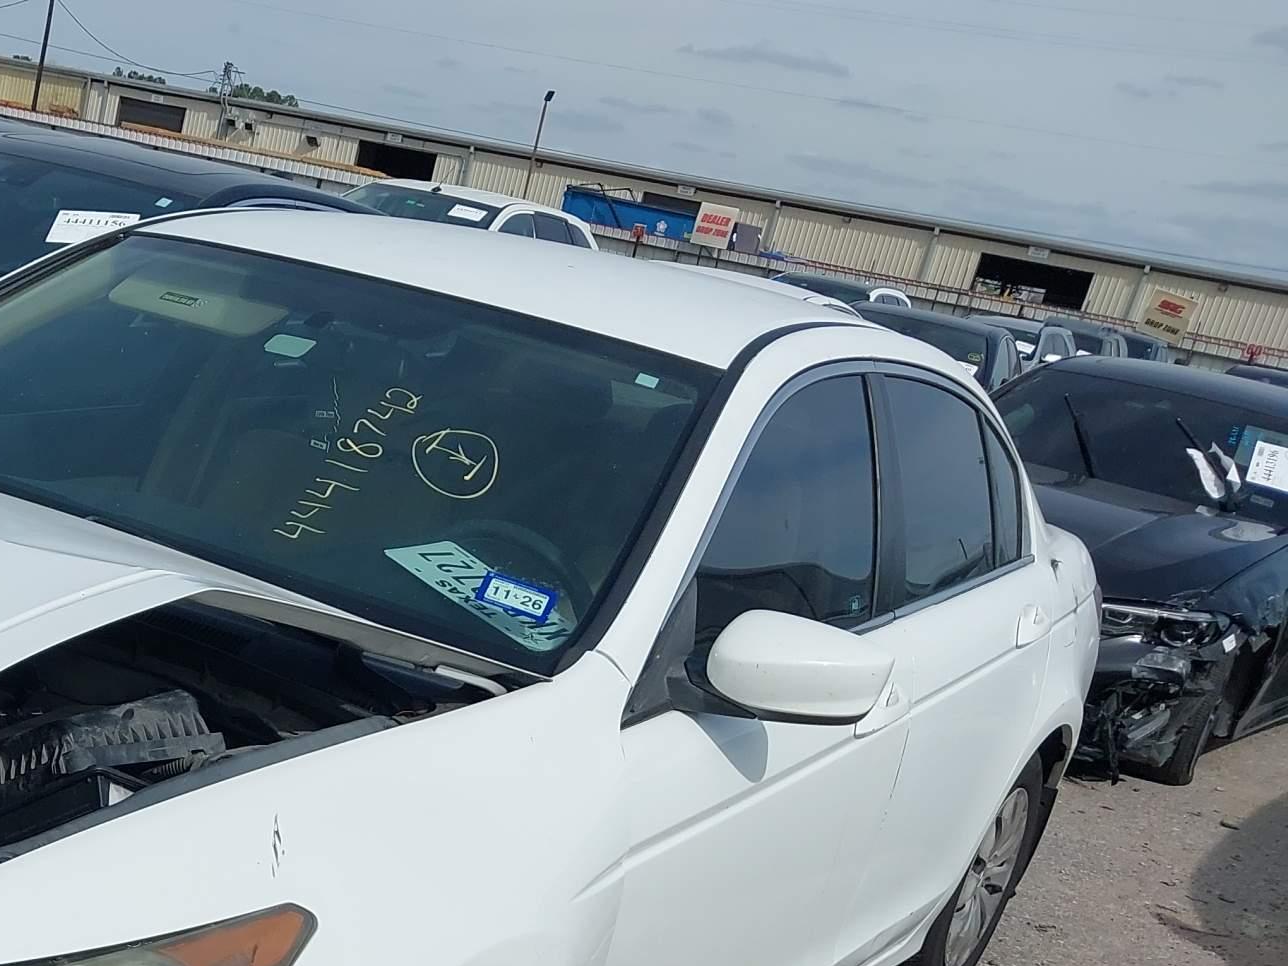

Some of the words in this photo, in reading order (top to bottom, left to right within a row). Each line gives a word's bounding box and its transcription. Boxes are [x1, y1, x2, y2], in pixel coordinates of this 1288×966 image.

[701, 213, 731, 226] DEALER
[273, 387, 424, 539] 44418742
[434, 579, 497, 619] TEXAS
[491, 585, 511, 600] 11
[519, 595, 544, 611] 26
